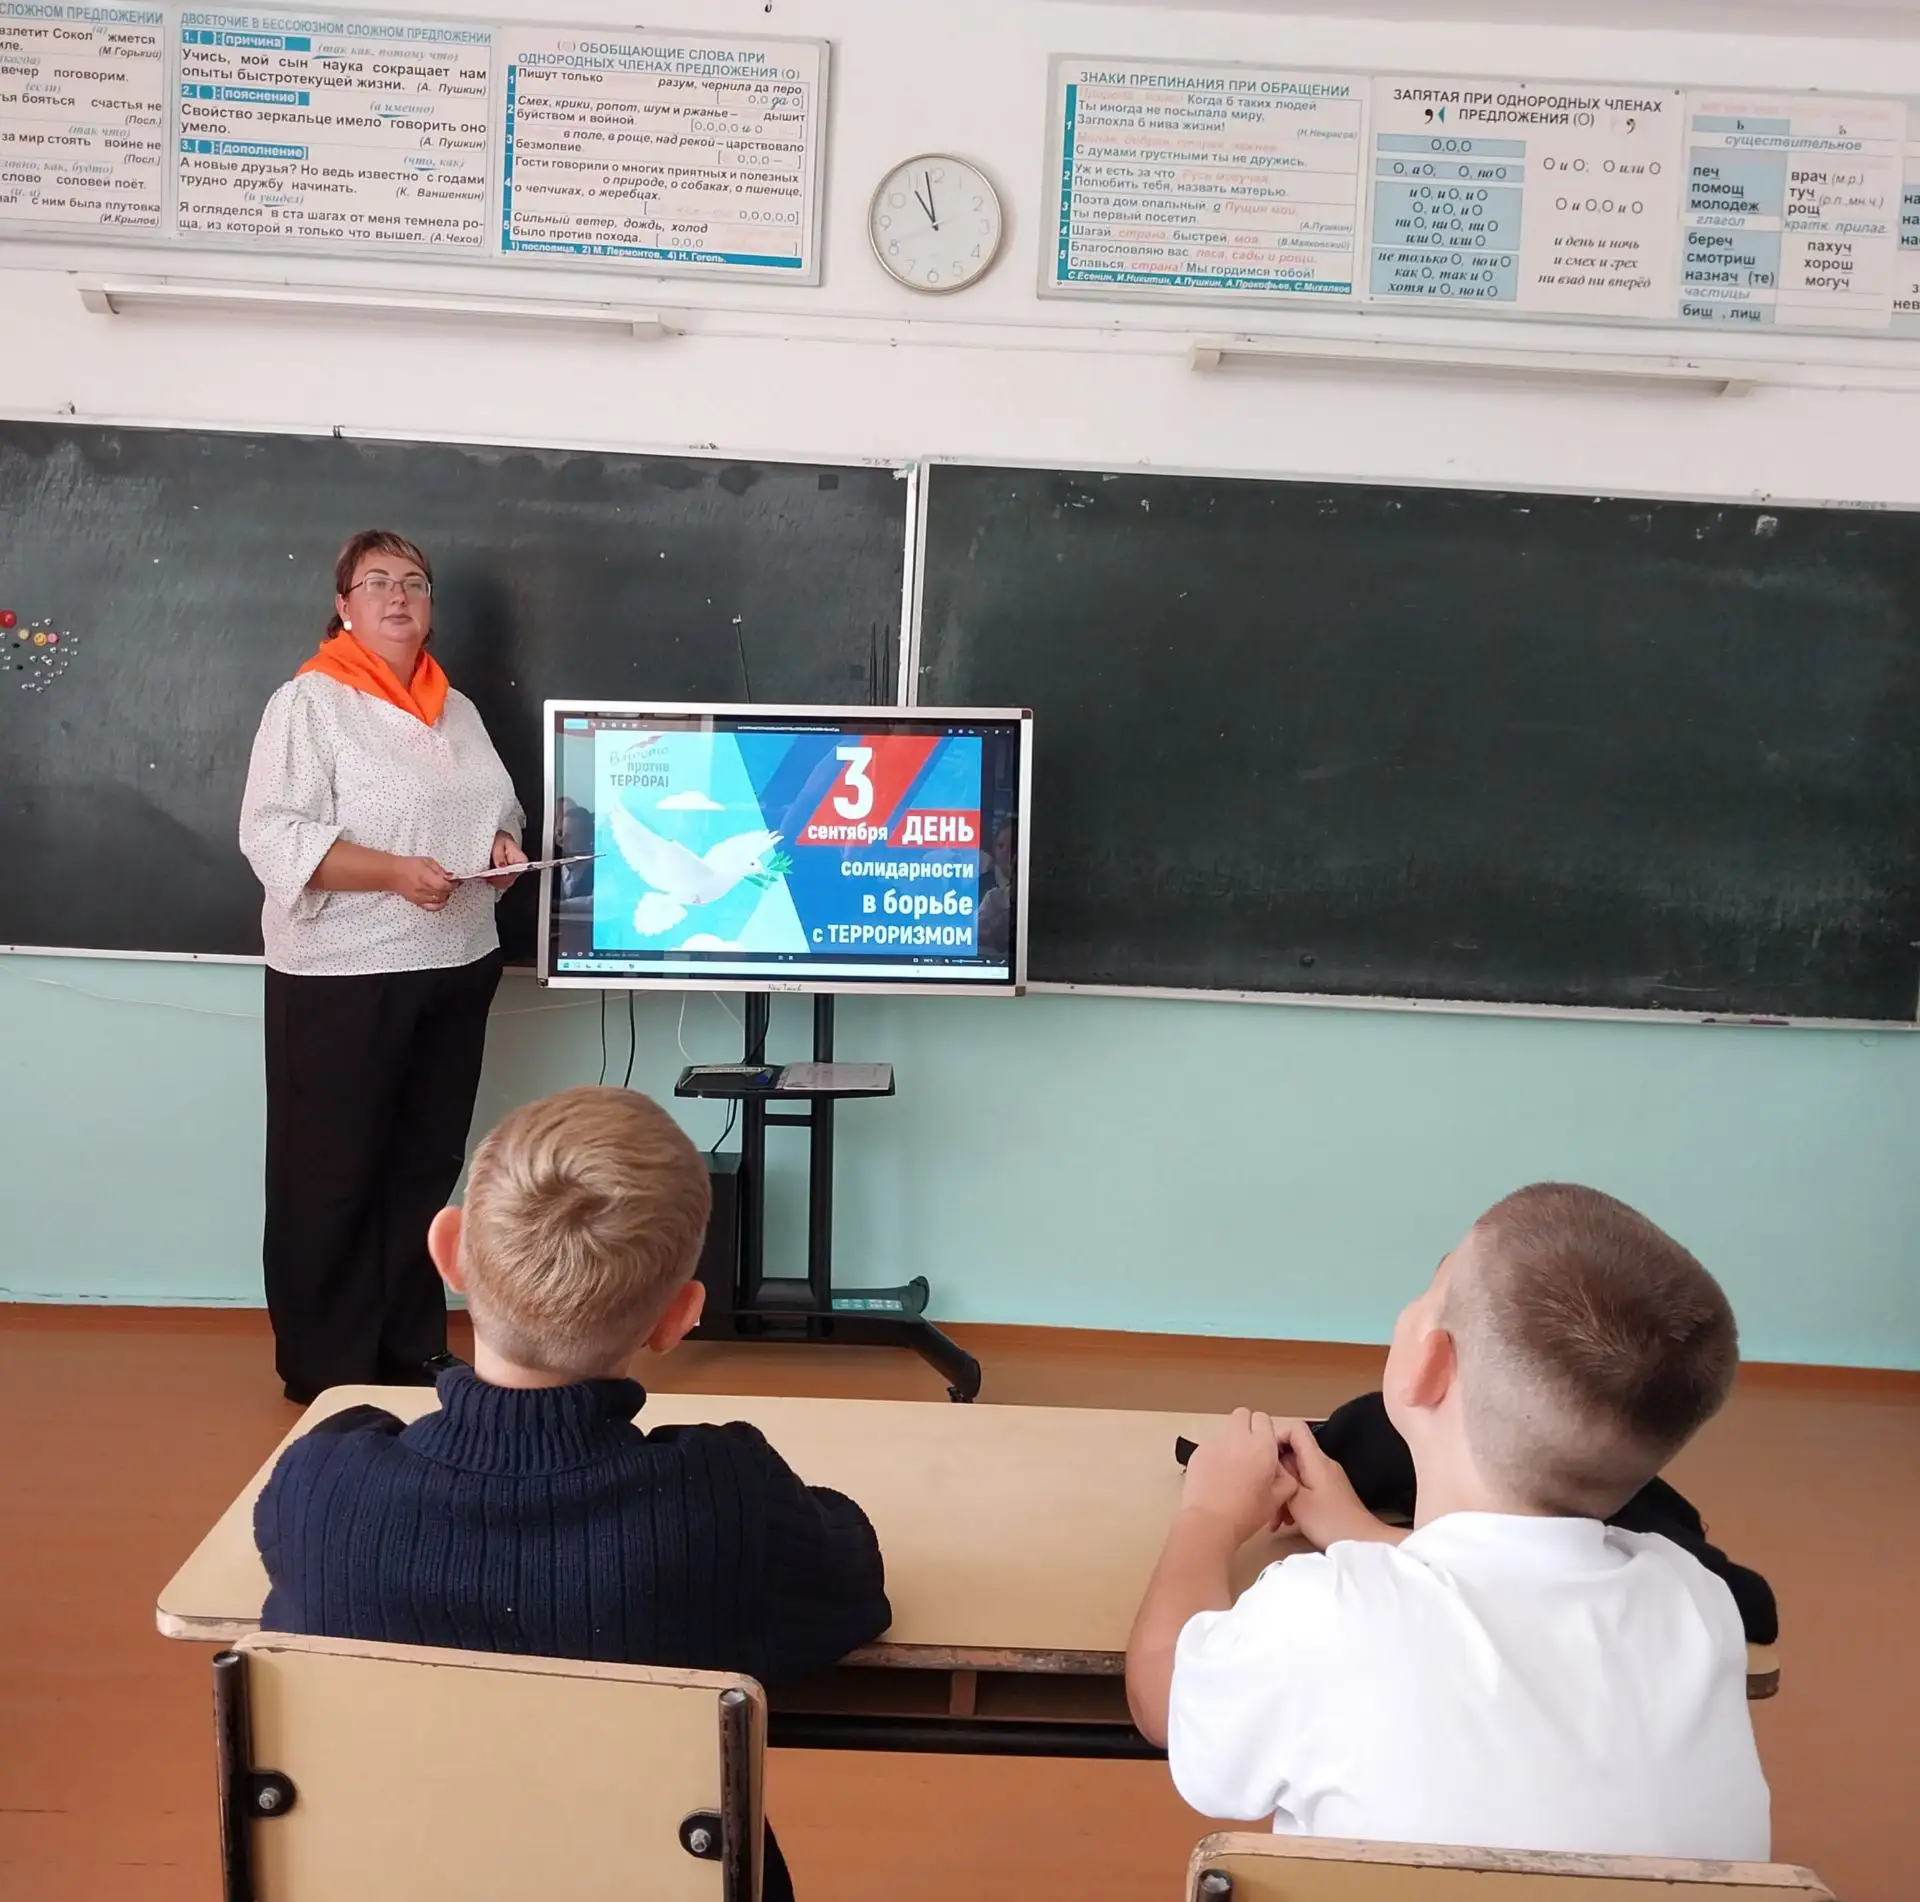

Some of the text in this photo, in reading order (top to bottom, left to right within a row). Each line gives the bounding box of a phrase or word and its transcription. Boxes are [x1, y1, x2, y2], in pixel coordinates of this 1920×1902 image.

[67, 7, 163, 24] ПРЕДЛОЖЕНИИ
[53, 27, 93, 41] Сокол
[181, 13, 491, 43] ДВОЕТОЧИЕ В БЕССОЮЗНОМ СЛОЖНОМ ПРЕДЛОЖЕНИИ
[580, 42, 765, 63] ОБОБЩАЮЩИЕ СЛОВА ПРИ
[183, 49, 486, 79] Учись, мой сын наука сокращает нам
[518, 53, 777, 78] ОДНОРОДНЫХ ЧЛЕНАХ ПРЕДЛОЖЕНИЯ
[54, 69, 129, 82] поговорим.
[183, 68, 232, 79] опыты
[238, 68, 352, 88] быстротекущей
[357, 79, 405, 90] жизни.
[439, 85, 486, 96] Пушкин)
[519, 68, 557, 81] Пишут
[561, 71, 603, 82] только
[658, 77, 697, 88] разум,
[702, 81, 751, 91] чернила
[755, 84, 769, 93] да
[1081, 72, 1349, 96] ЗНАКИ ПРЕПИНАНИЯ ПРИ ОБРАЩЕНИИ
[22, 93, 161, 111] бояться счастья не
[1394, 89, 1662, 112] ЗАПЯТАЯ ПРИ ОДНОРОДНЫХ ЧЛЕНАХ
[517, 109, 575, 121] буйством
[644, 105, 670, 115] шум
[683, 107, 728, 117] ржанье
[764, 113, 805, 121] дышит
[1079, 101, 1096, 111] Ты
[1100, 102, 1142, 113] иногда
[1146, 106, 1160, 115] не
[1165, 107, 1227, 118] посылала
[1459, 109, 1569, 124] ПРЕДЛОЖЕНИЯ
[182, 104, 486, 133] Свойство зеркальце имело говорить оно
[1077, 115, 1134, 127] Заглохла
[1150, 120, 1179, 129] нива
[1183, 122, 1224, 131] жизни!
[2, 133, 161, 150] за мир стоять войне не
[181, 122, 230, 134] умело.
[439, 138, 486, 149] Пушкин)
[181, 157, 189, 167] А
[195, 161, 238, 170] новые
[241, 163, 296, 175] друзья?
[301, 165, 318, 175] Но
[323, 168, 354, 179] ведь
[358, 170, 418, 181] известно
[438, 175, 484, 185] годами
[516, 157, 549, 167] Гости
[552, 160, 608, 172] говорили
[622, 164, 664, 174] многих
[668, 168, 727, 179] приятных
[740, 172, 799, 182] полезных
[2, 174, 41, 183] слово
[56, 176, 110, 187] соловей
[32, 197, 160, 213] с ним была плутовка
[880, 215, 891, 231] 9
[889, 239, 899, 256] 8
[971, 244, 980, 258] 4
[1071, 242, 1163, 256] Благословляю
[1554, 236, 1640, 249] и день и ночь
[1187, 263, 1207, 273] Мы
[1212, 266, 1270, 277] гордимся
[1275, 267, 1315, 279] тобой!
[1554, 257, 1638, 271] и смех и грех
[927, 268, 939, 283] 6
[628, 762, 669, 773] против
[610, 775, 668, 787] ТЕРРОРА!
[833, 747, 873, 820] 3
[808, 816, 974, 843] сентября ДЕНЬ
[841, 862, 974, 880] солидарности
[863, 889, 973, 919] в борьбе
[813, 925, 972, 945] с ТЕРРОРИЗМОМ
